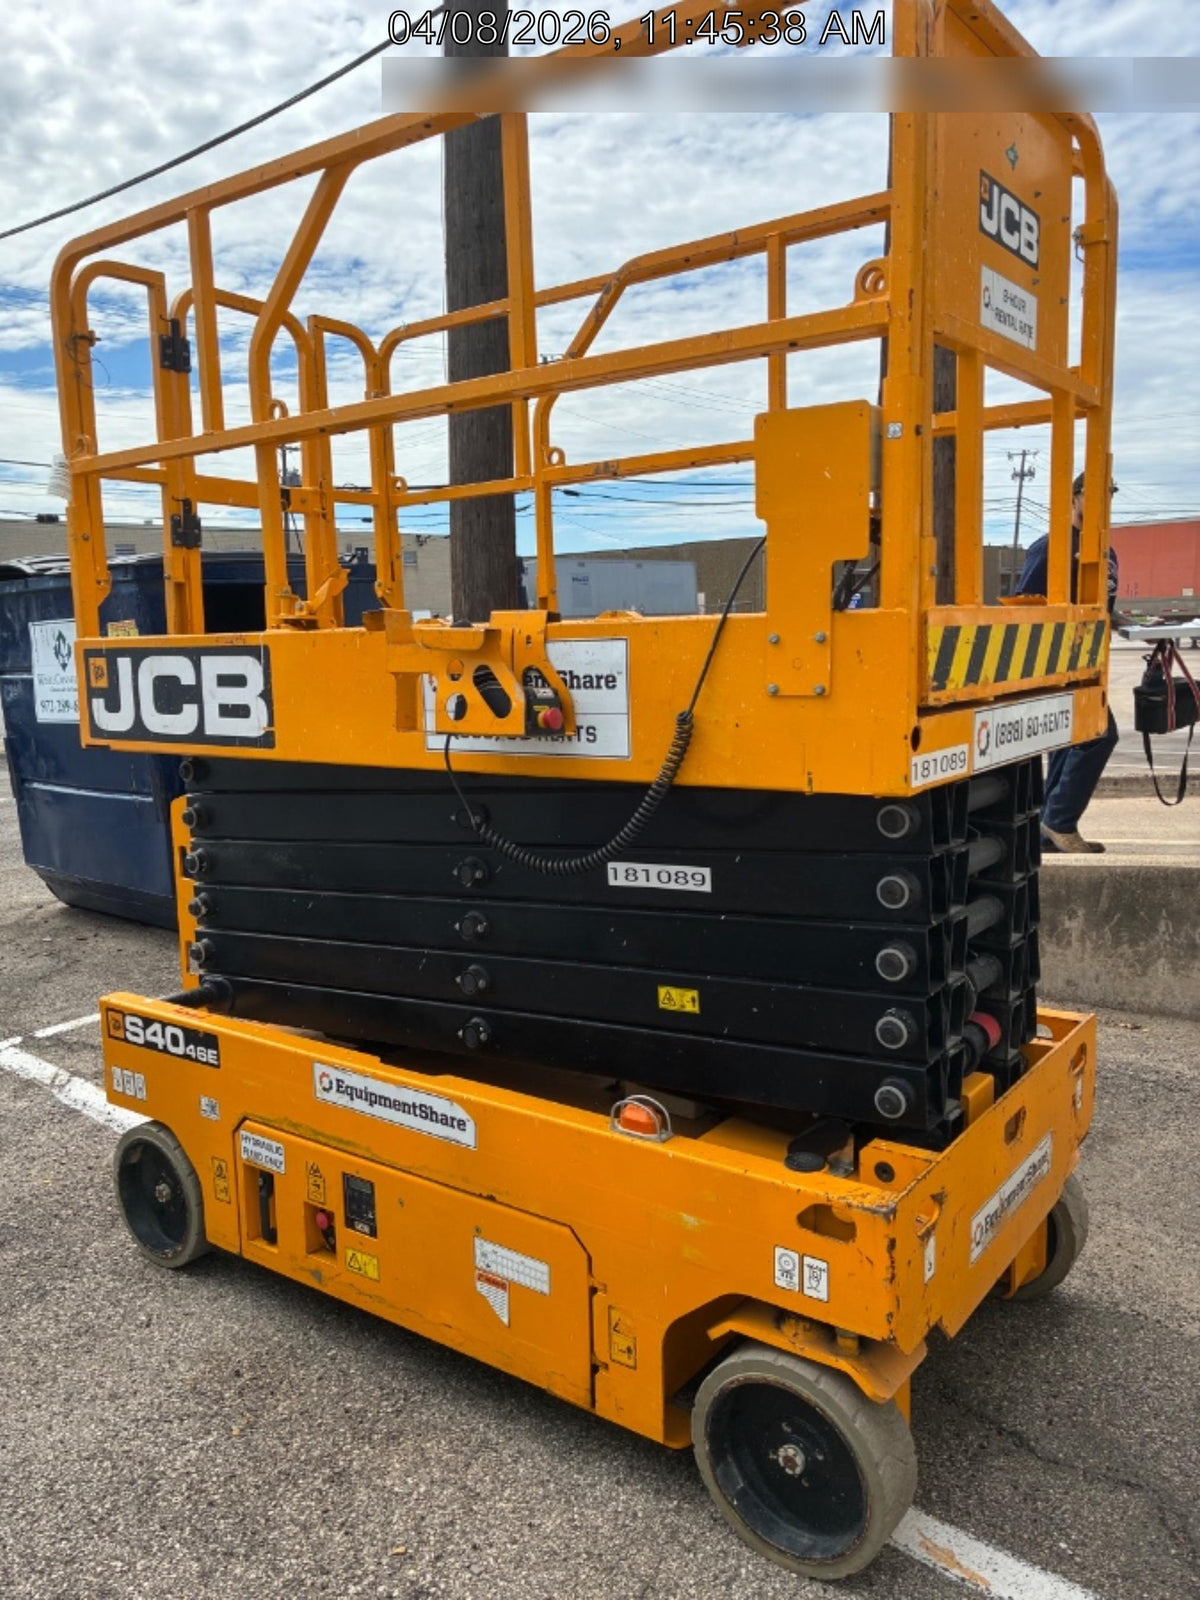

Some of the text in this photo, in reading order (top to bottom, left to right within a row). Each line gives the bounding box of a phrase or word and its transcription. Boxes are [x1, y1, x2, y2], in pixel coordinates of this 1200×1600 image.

[980, 184, 1039, 264] JCB
[994, 306, 1018, 332] RENTAL
[91, 655, 269, 737] JCB
[995, 709, 1071, 748] (888) 80-RENTS
[911, 752, 967, 781] 181089
[609, 866, 706, 887] 181089
[335, 1078, 467, 1132] EquipmentShare
[241, 1133, 284, 1157] HYDRAULIC
